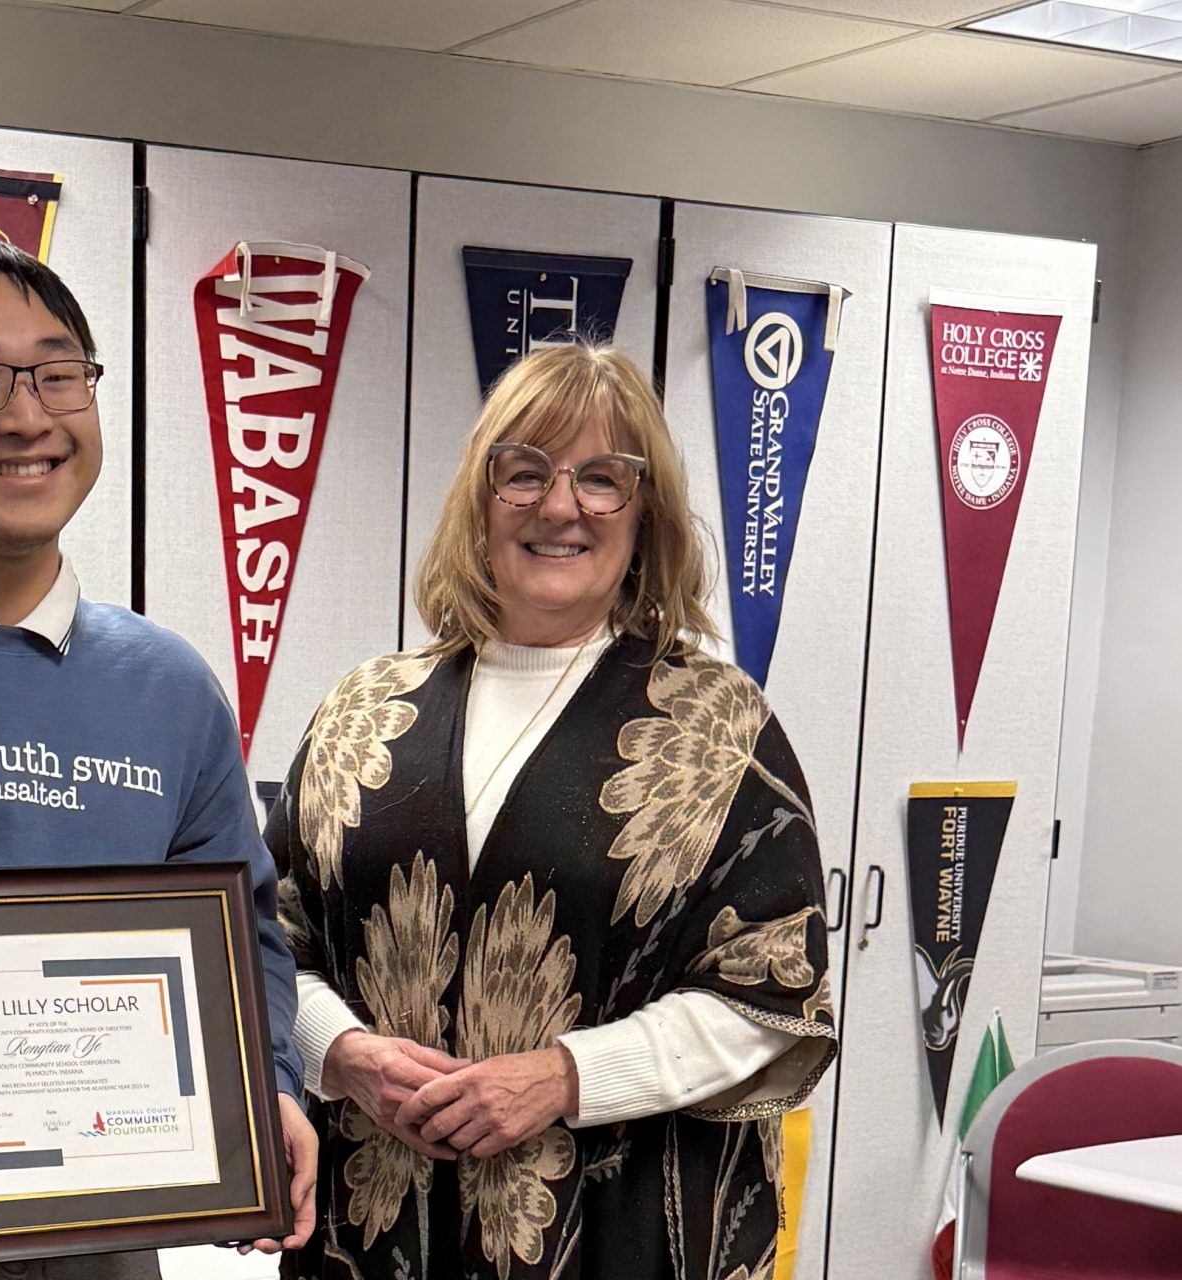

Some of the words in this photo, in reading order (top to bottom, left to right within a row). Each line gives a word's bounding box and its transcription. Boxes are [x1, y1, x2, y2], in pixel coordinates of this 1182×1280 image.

[941, 343, 1018, 369] COLLEGE
[942, 322, 987, 345] HOLY
[989, 327, 1045, 350] CROSS
[940, 366, 948, 374] at
[948, 366, 967, 376] Notre
[989, 369, 1016, 380] Indiana
[750, 389, 769, 457] STATE
[953, 428, 967, 452] HOLY
[968, 418, 991, 431] CROSS
[991, 420, 1017, 456] COLLEGE
[765, 391, 790, 498] GRAND
[215, 273, 341, 664] WABASH
[951, 465, 964, 496] NOTRE
[965, 493, 987, 505] DAME
[991, 468, 1017, 502] INDIANA
[742, 459, 765, 597] UNIVERSITY
[759, 496, 784, 596] VALLEY
[72, 754, 164, 797] swim
[941, 807, 956, 861] FORT
[956, 807, 967, 860] PURDUE
[937, 868, 953, 942] WAYNE
[952, 863, 963, 941] UNIVERSITY
[1, 998, 48, 1016] LILLY
[53, 995, 140, 1014] SCHOLAR
[3, 1036, 71, 1061] Rongtian
[73, 1033, 111, 1059] Ye
[18, 1062, 55, 1070] COMMUNITY
[78, 1059, 120, 1067] CORPORATION
[106, 1114, 177, 1126] COMMUNITY
[107, 1124, 178, 1136] FOUNDATION
